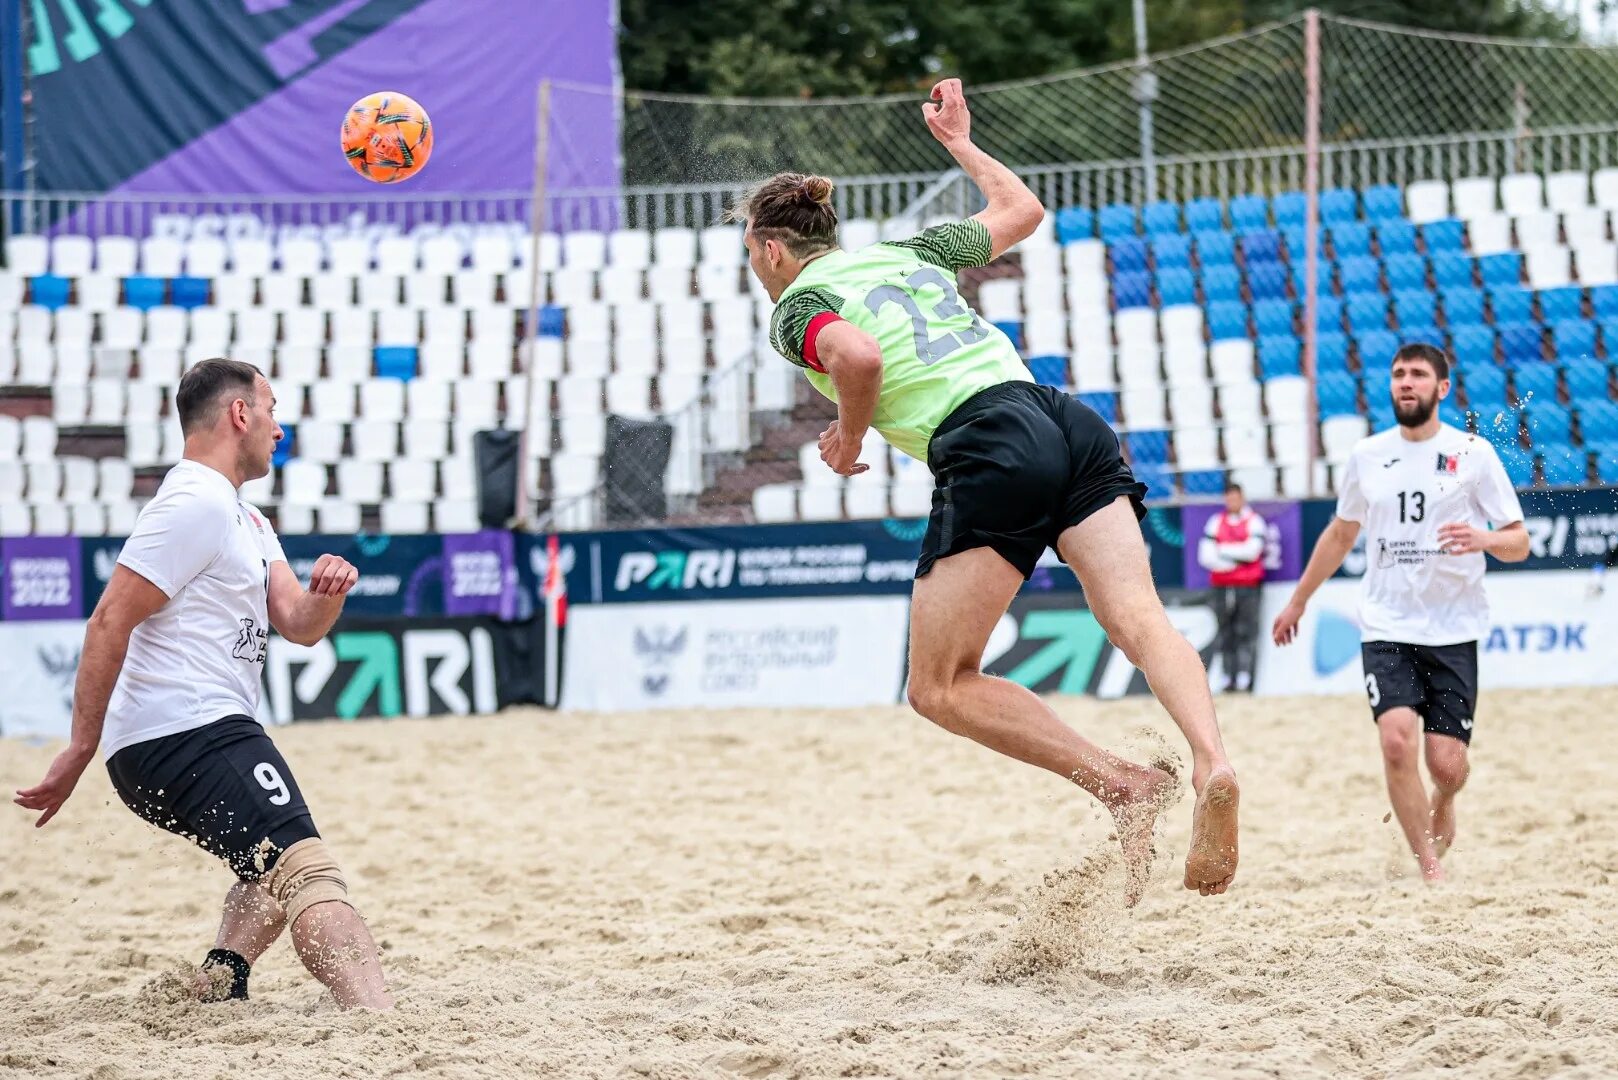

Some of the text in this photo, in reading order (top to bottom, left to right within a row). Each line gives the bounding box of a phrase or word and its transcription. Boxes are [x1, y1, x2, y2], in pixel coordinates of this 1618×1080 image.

[863, 267, 989, 366] 23
[1397, 491, 1426, 523] 13
[1521, 515, 1569, 558] RI
[615, 548, 737, 591] PARI
[11, 577, 72, 607] 2022
[1485, 624, 1586, 651] АТЭК
[264, 627, 499, 724] PARI
[253, 762, 291, 806] 9
